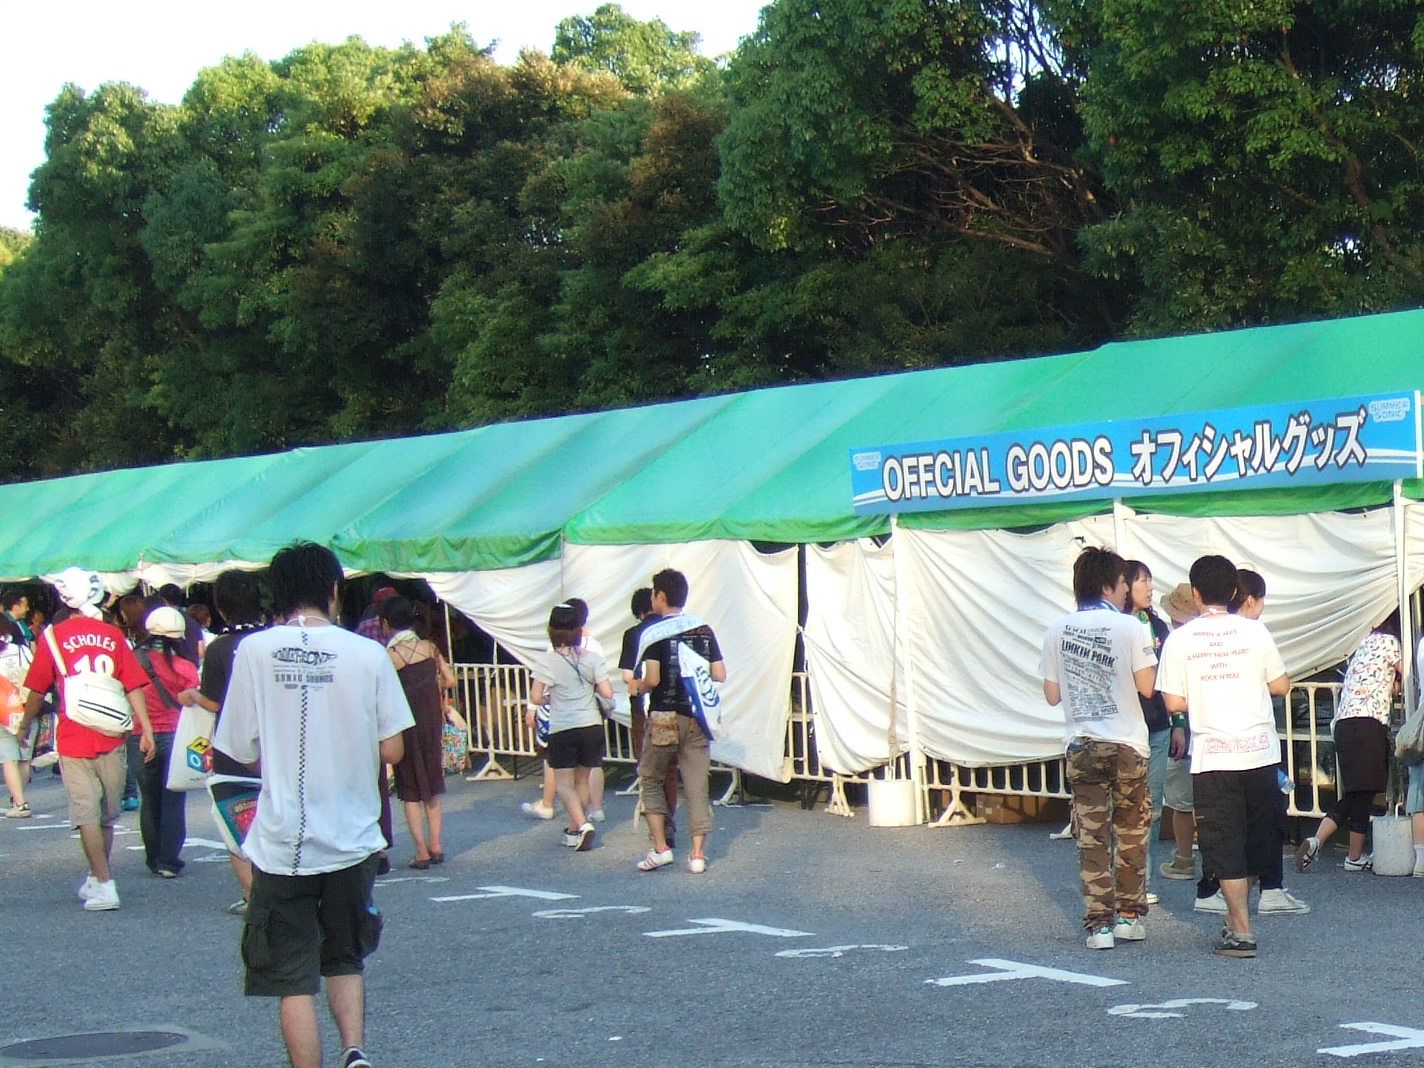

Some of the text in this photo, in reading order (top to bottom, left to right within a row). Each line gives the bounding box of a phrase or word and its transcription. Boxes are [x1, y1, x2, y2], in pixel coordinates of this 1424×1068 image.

[882, 404, 1368, 502] OFFCIAL GOODS オフィシャルグッズ
[63, 633, 117, 653] SCHOLES
